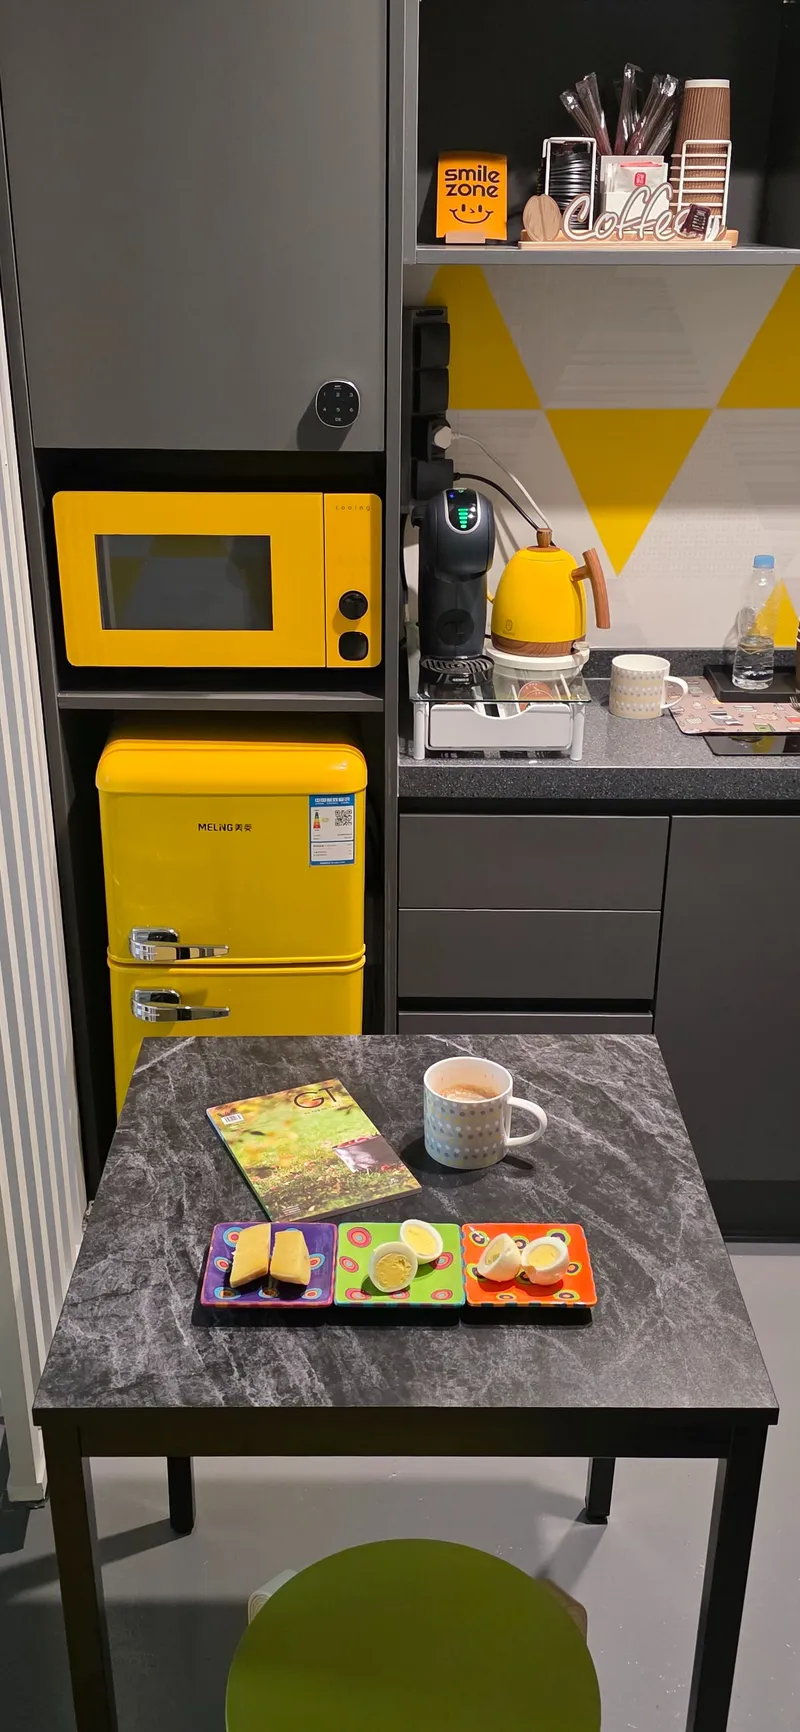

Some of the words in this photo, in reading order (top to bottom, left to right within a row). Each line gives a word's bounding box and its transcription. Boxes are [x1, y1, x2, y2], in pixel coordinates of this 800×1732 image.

[444, 164, 500, 183] smile
[445, 183, 499, 198] zone
[293, 1086, 337, 1109] GT
